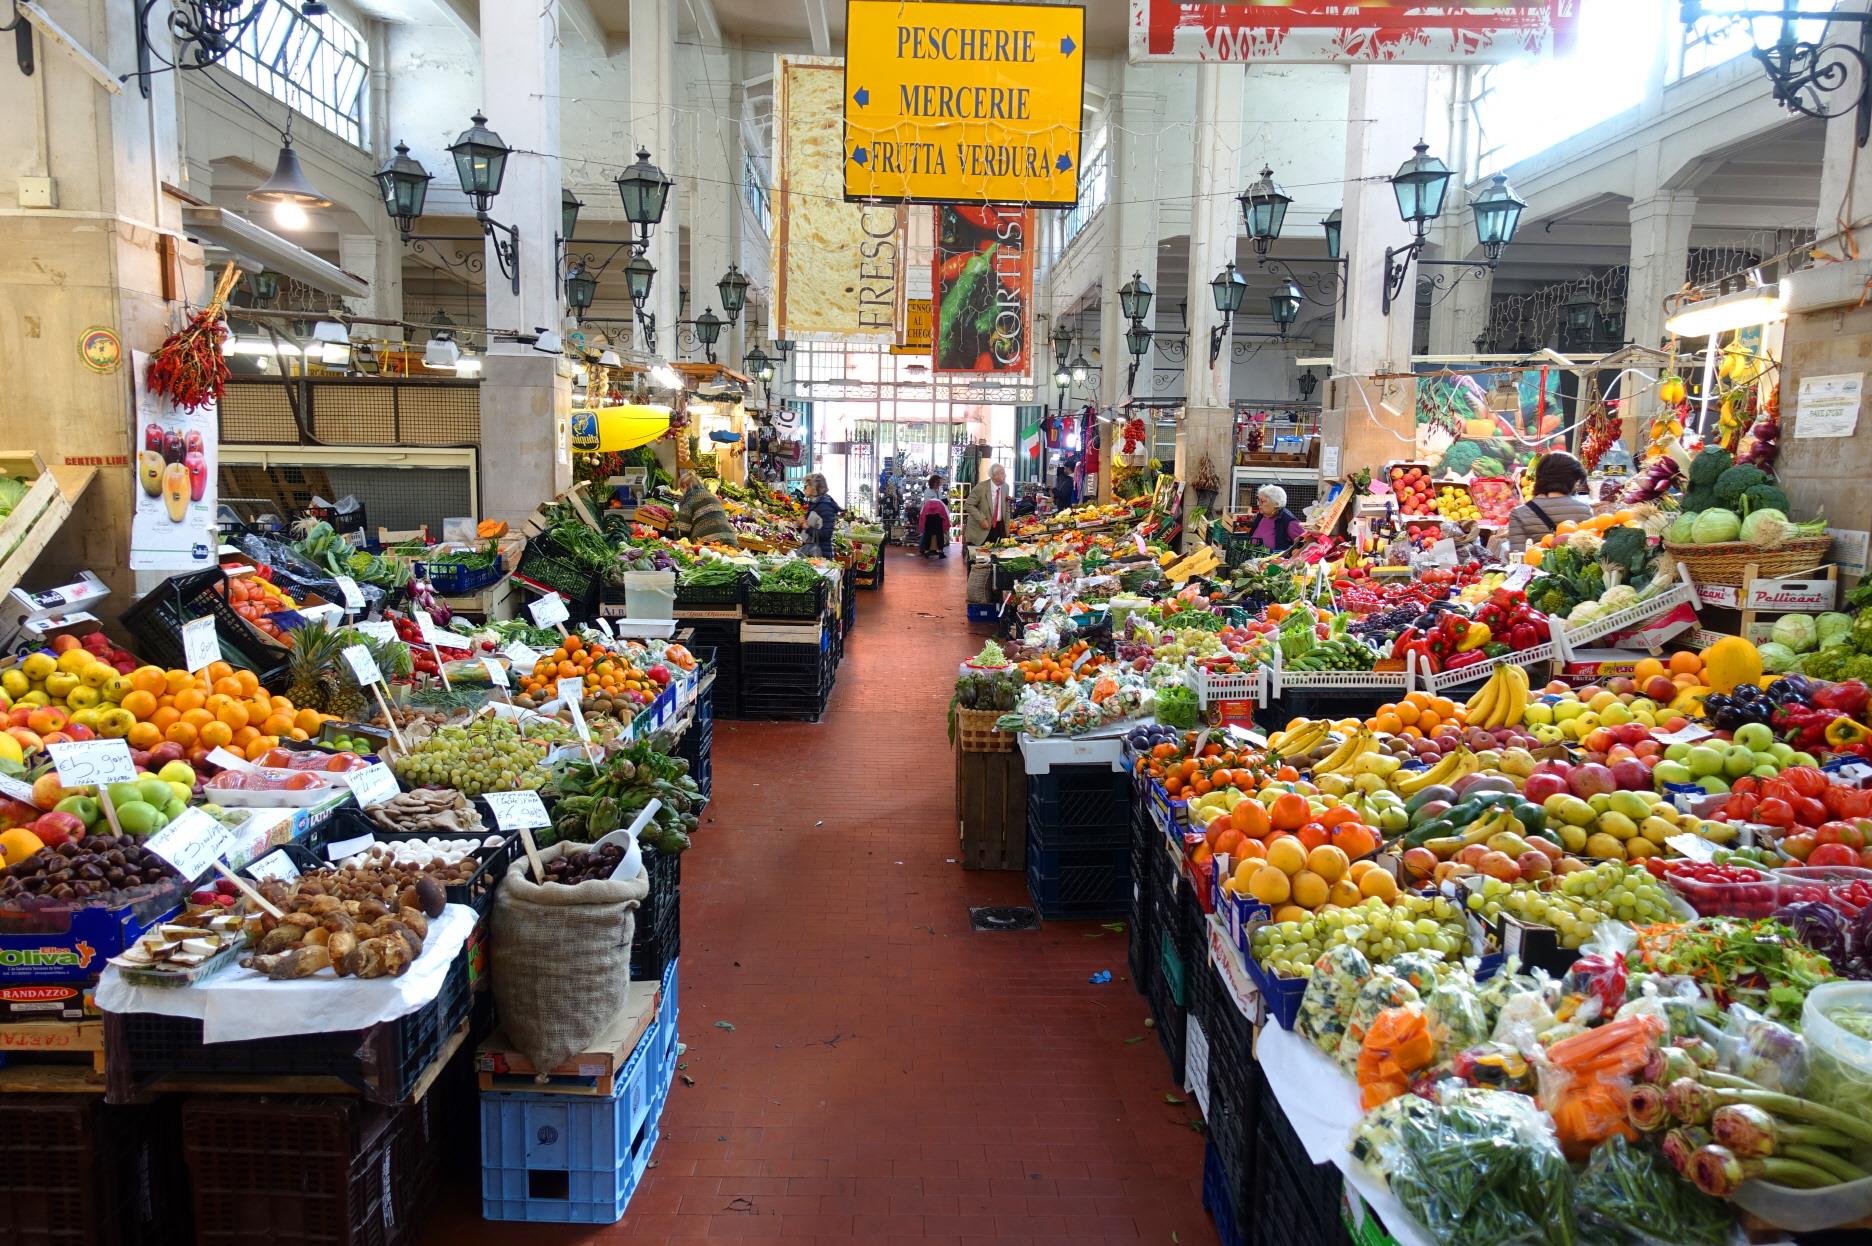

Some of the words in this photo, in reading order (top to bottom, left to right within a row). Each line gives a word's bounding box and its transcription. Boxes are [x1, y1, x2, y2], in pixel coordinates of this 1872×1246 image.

[896, 26, 1036, 63] PESCHERIE
[898, 84, 1031, 120] MERCERIE
[870, 141, 946, 175] FRUTTA
[957, 143, 1050, 178] VERDURA
[994, 207, 1023, 365] CORTESI
[914, 317, 923, 325] AL
[64, 456, 103, 466] CENTER
[106, 456, 129, 464] LINE
[1755, 591, 1822, 603] Pellicani
[3, 988, 69, 999] RANDAZZO
